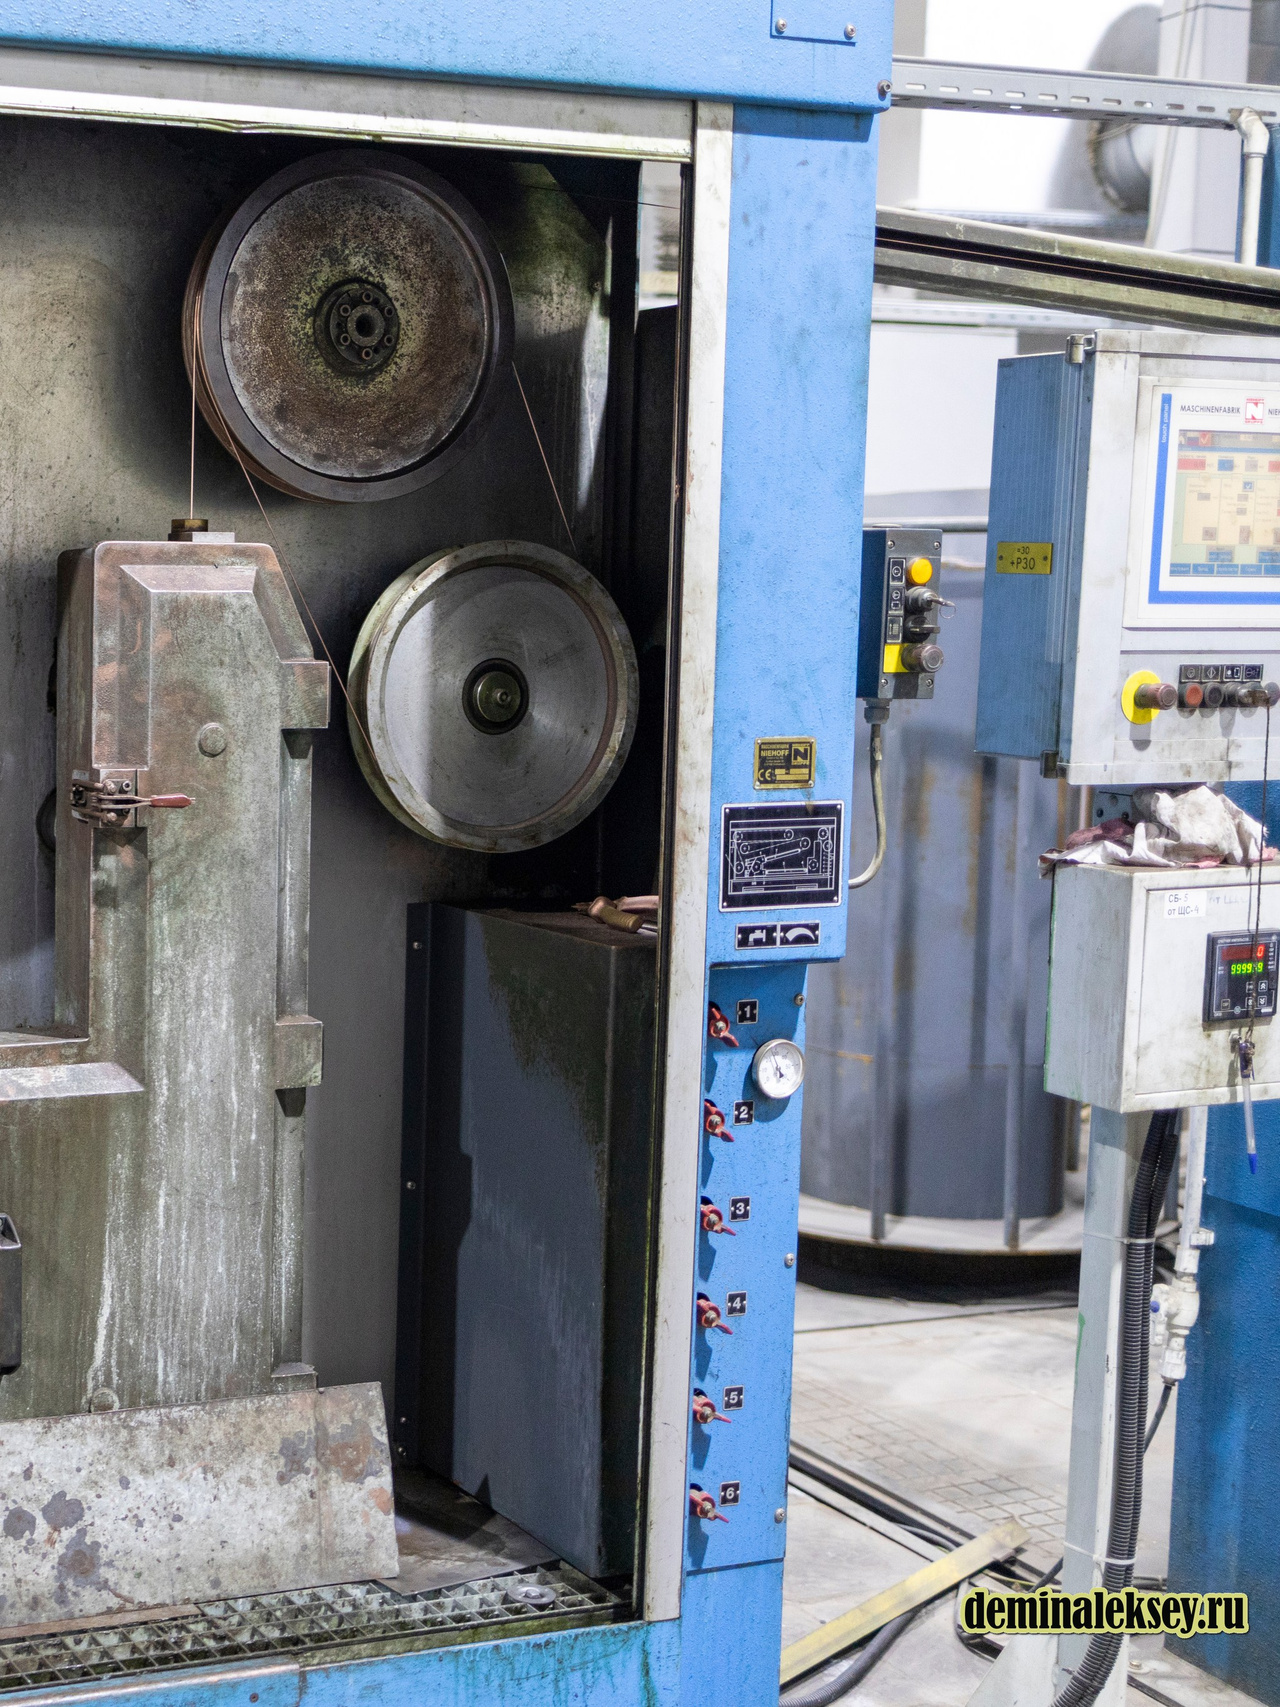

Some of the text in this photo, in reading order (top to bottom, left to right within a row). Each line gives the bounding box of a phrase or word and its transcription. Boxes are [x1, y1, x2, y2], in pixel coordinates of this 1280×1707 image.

[1180, 404, 1240, 414] MASCHINENFABRIK
[1017, 546, 1030, 555] =30
[1010, 557, 1036, 570] +P30
[1167, 908, 1176, 916] от
[1256, 944, 1266, 959] 0
[1230, 962, 1264, 975] 99999
[744, 1005, 751, 1018] 1
[739, 1106, 748, 1118] 2
[735, 1202, 745, 1215] 3
[732, 1297, 741, 1310] 4
[729, 1392, 738, 1404] 5
[726, 1487, 735, 1499] 6
